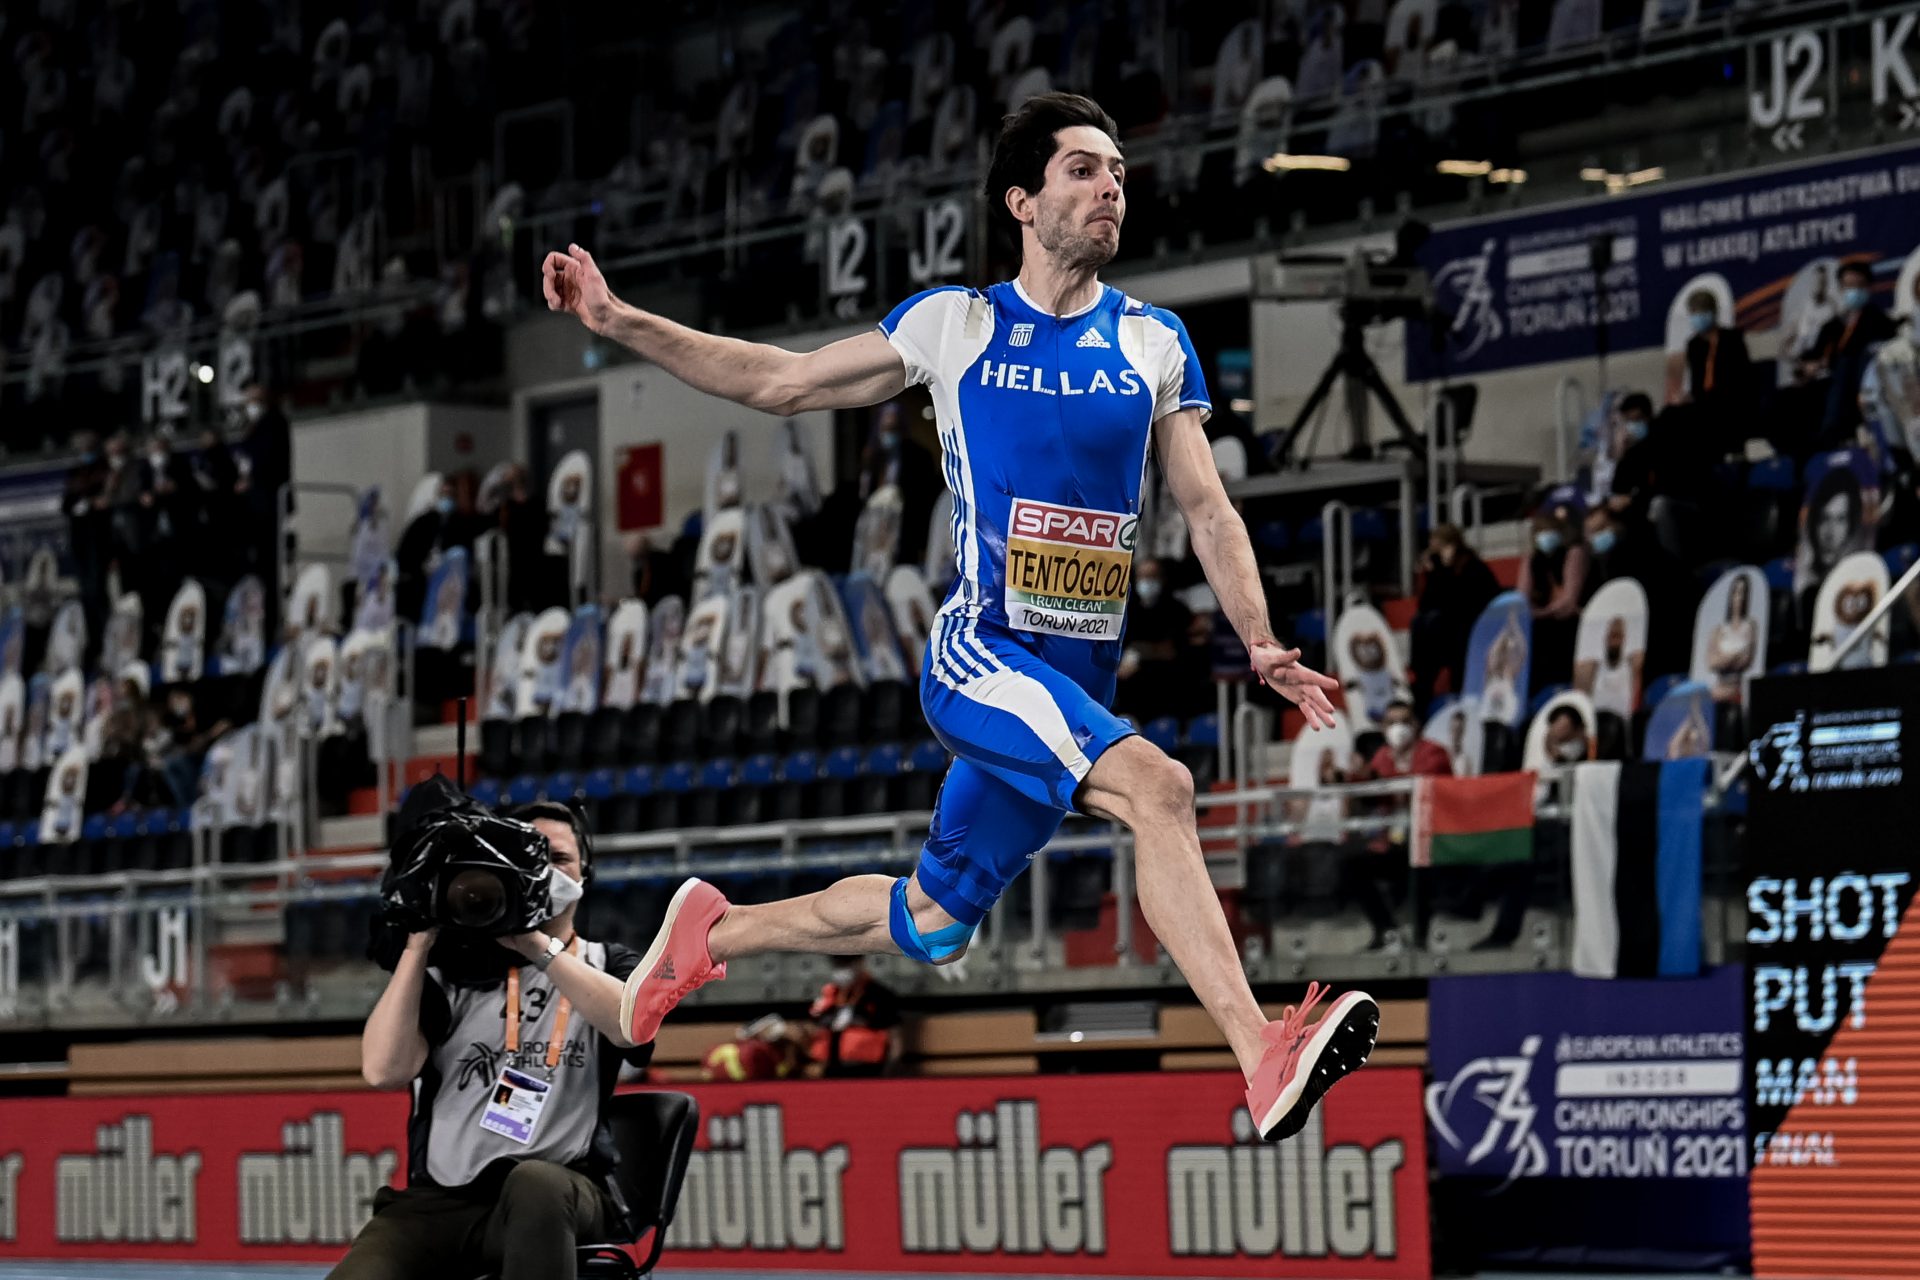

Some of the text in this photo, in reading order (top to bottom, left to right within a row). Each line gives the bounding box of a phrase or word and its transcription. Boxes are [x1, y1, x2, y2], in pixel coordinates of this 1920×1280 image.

[1751, 30, 1825, 127] J2
[1871, 12, 1920, 105] K
[909, 202, 963, 281] J2
[1076, 337, 1111, 349] adidas
[142, 352, 188, 422] H2
[981, 360, 1140, 396] HELLAS
[1016, 507, 1115, 543] SPAR
[1023, 609, 1108, 634] TORUŃ 2021
[1036, 595, 1062, 609] RUN
[1747, 871, 1911, 943] SHOT
[1754, 962, 1876, 1033] PUT
[1573, 1032, 1743, 1059] EUROPEAN ATHLETICS
[1756, 1058, 1858, 1106] MAN
[1554, 1097, 1746, 1131] CHAMPIONSHIPS
[57, 1113, 201, 1243] müller
[899, 1099, 1113, 1254] müller
[1167, 1097, 1404, 1257] müller
[1555, 1130, 1747, 1178] TORUŃ 2021
